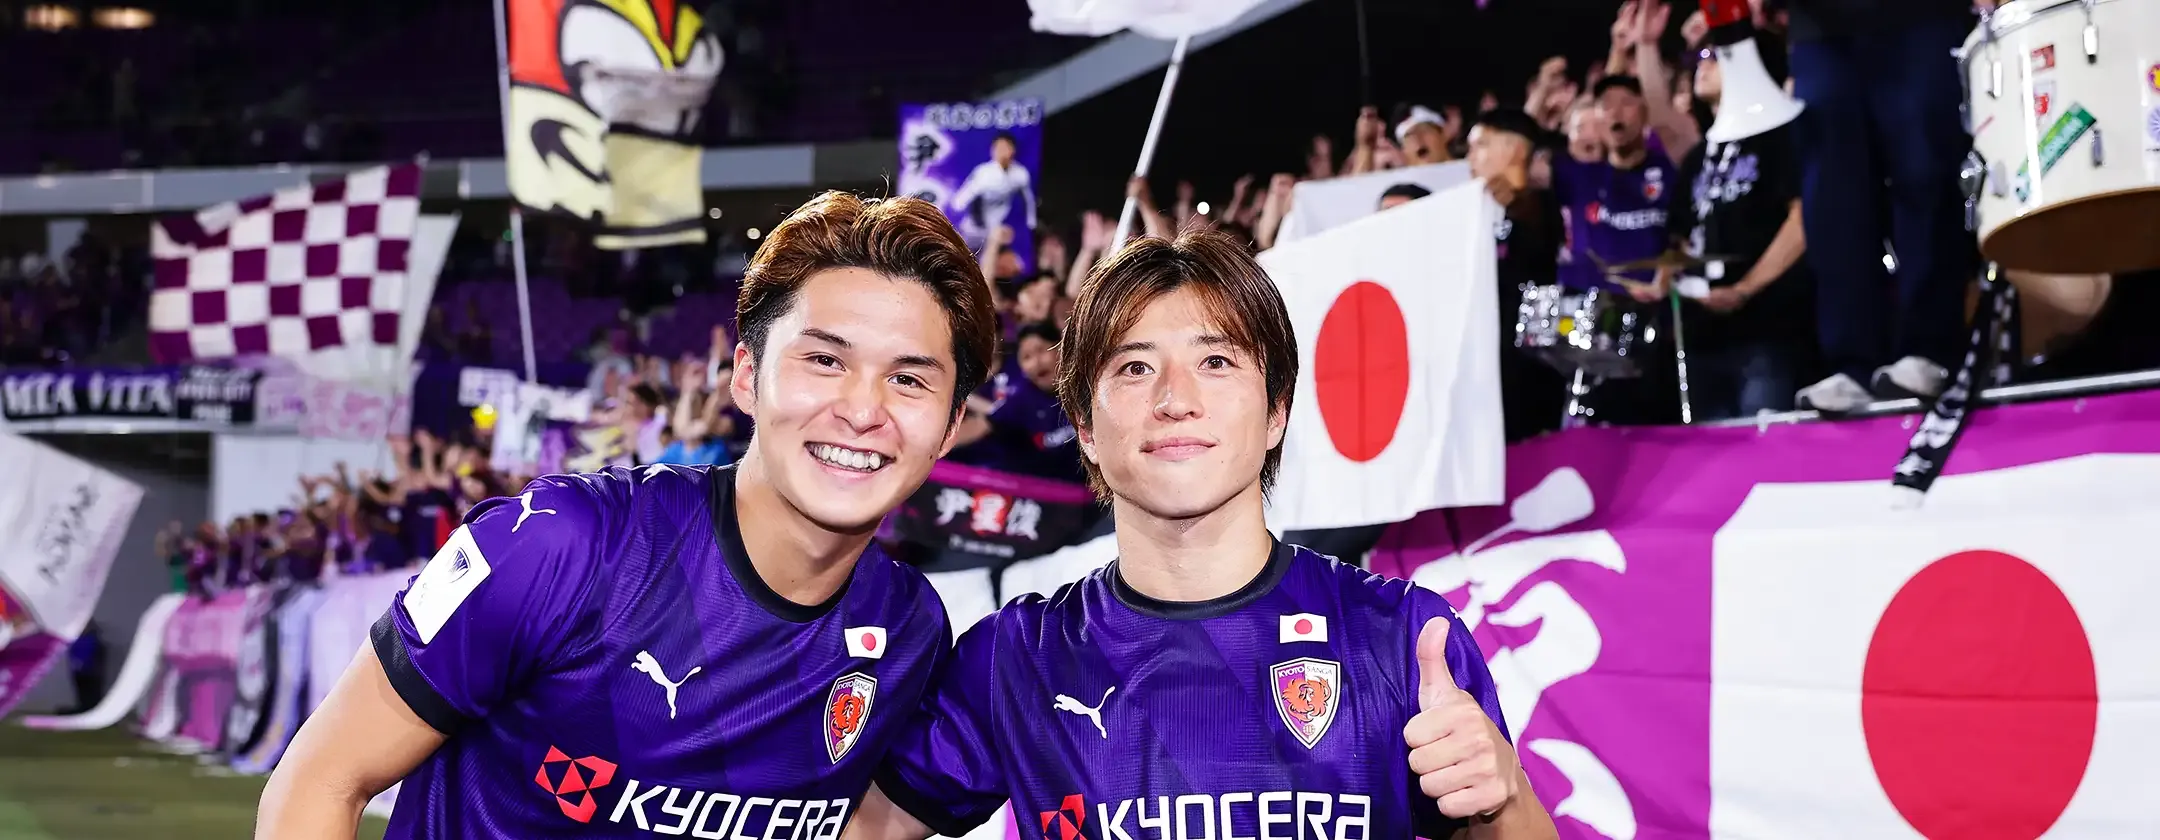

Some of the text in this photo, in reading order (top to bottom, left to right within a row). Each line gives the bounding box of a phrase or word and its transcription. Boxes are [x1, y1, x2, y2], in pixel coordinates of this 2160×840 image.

[1278, 665, 1333, 678] KYOTO SANGA
[609, 778, 850, 840] KYOCERA
[1097, 791, 1371, 840] KYOCERA
